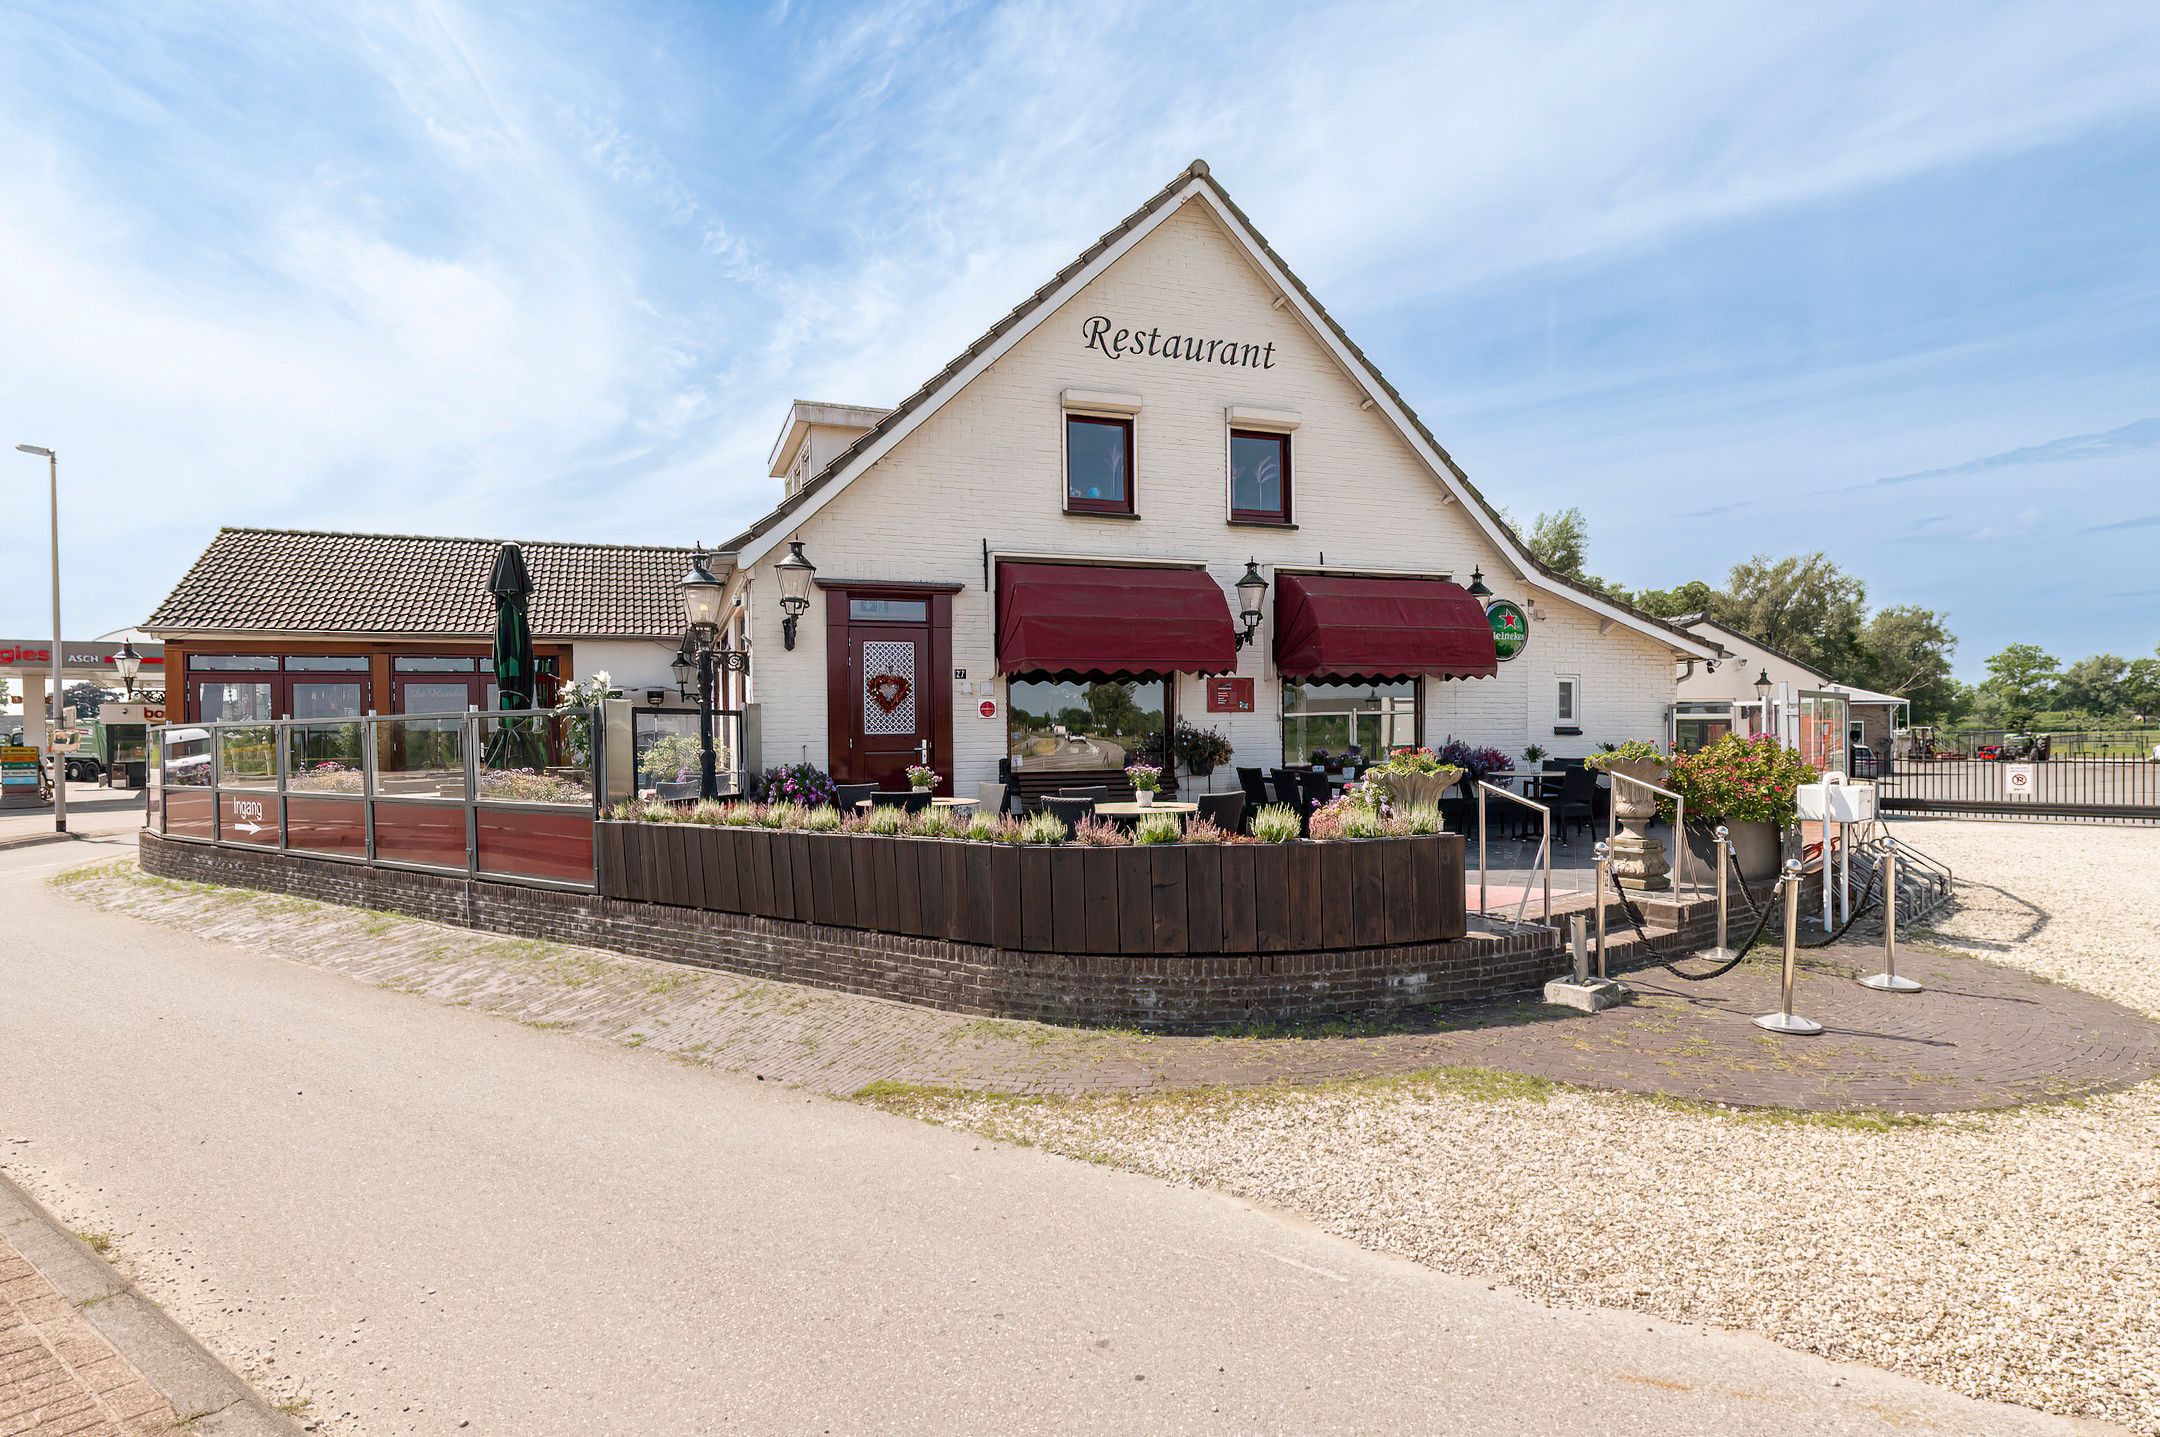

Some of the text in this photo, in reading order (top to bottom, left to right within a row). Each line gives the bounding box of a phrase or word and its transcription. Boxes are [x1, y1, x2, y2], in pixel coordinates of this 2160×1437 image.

[1082, 315, 1276, 370] Restaurant
[68, 654, 99, 663] ASCH
[233, 796, 262, 821] Ingang
